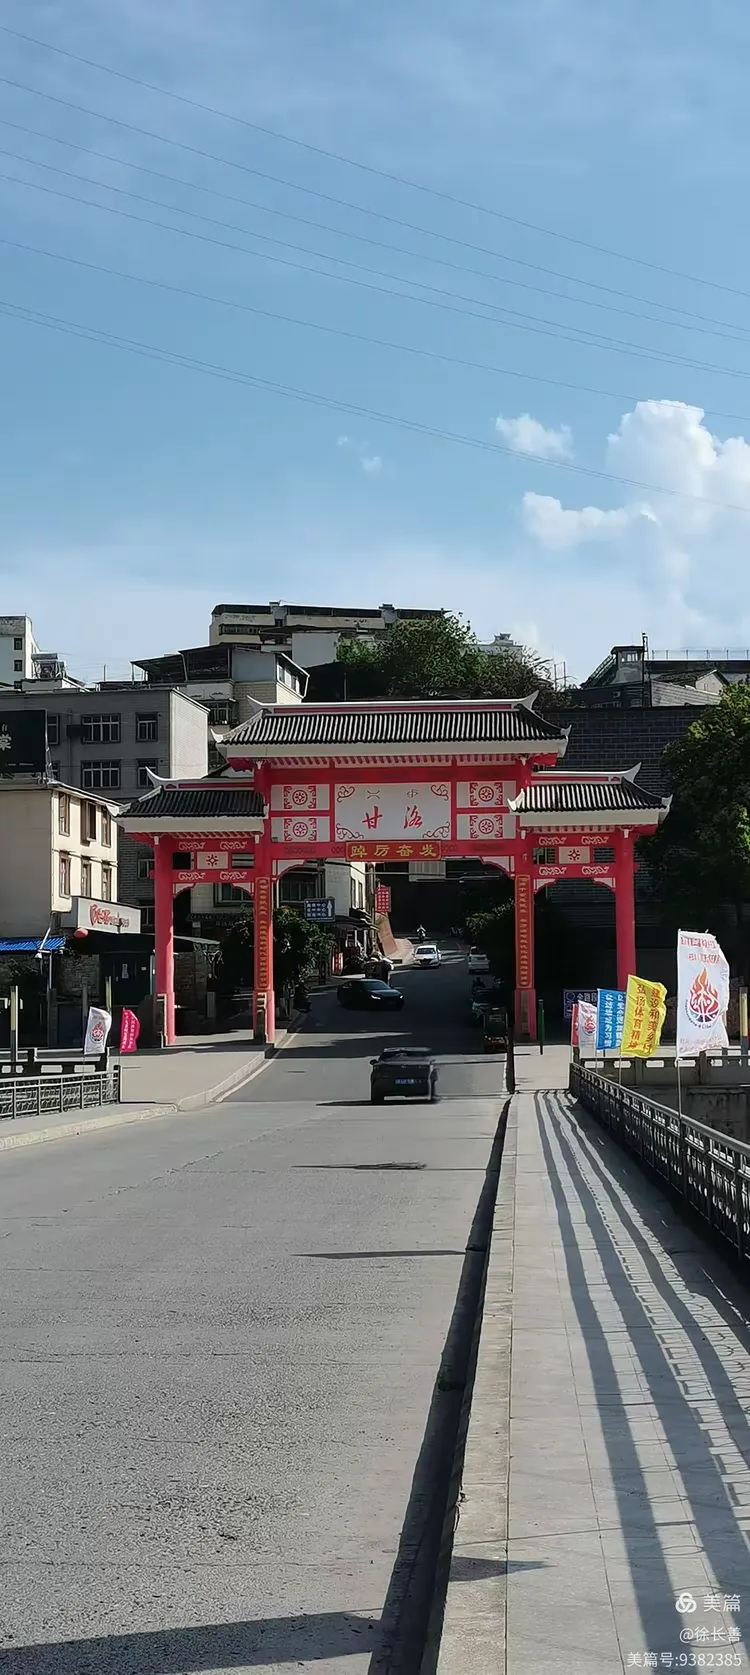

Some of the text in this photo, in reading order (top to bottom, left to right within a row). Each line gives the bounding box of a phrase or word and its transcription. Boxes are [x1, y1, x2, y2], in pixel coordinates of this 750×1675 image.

[362, 805, 423, 830] 甘洛
[350, 843, 437, 858] 踔厉奋发
[628, 983, 646, 1049] 弘扬体育精神
